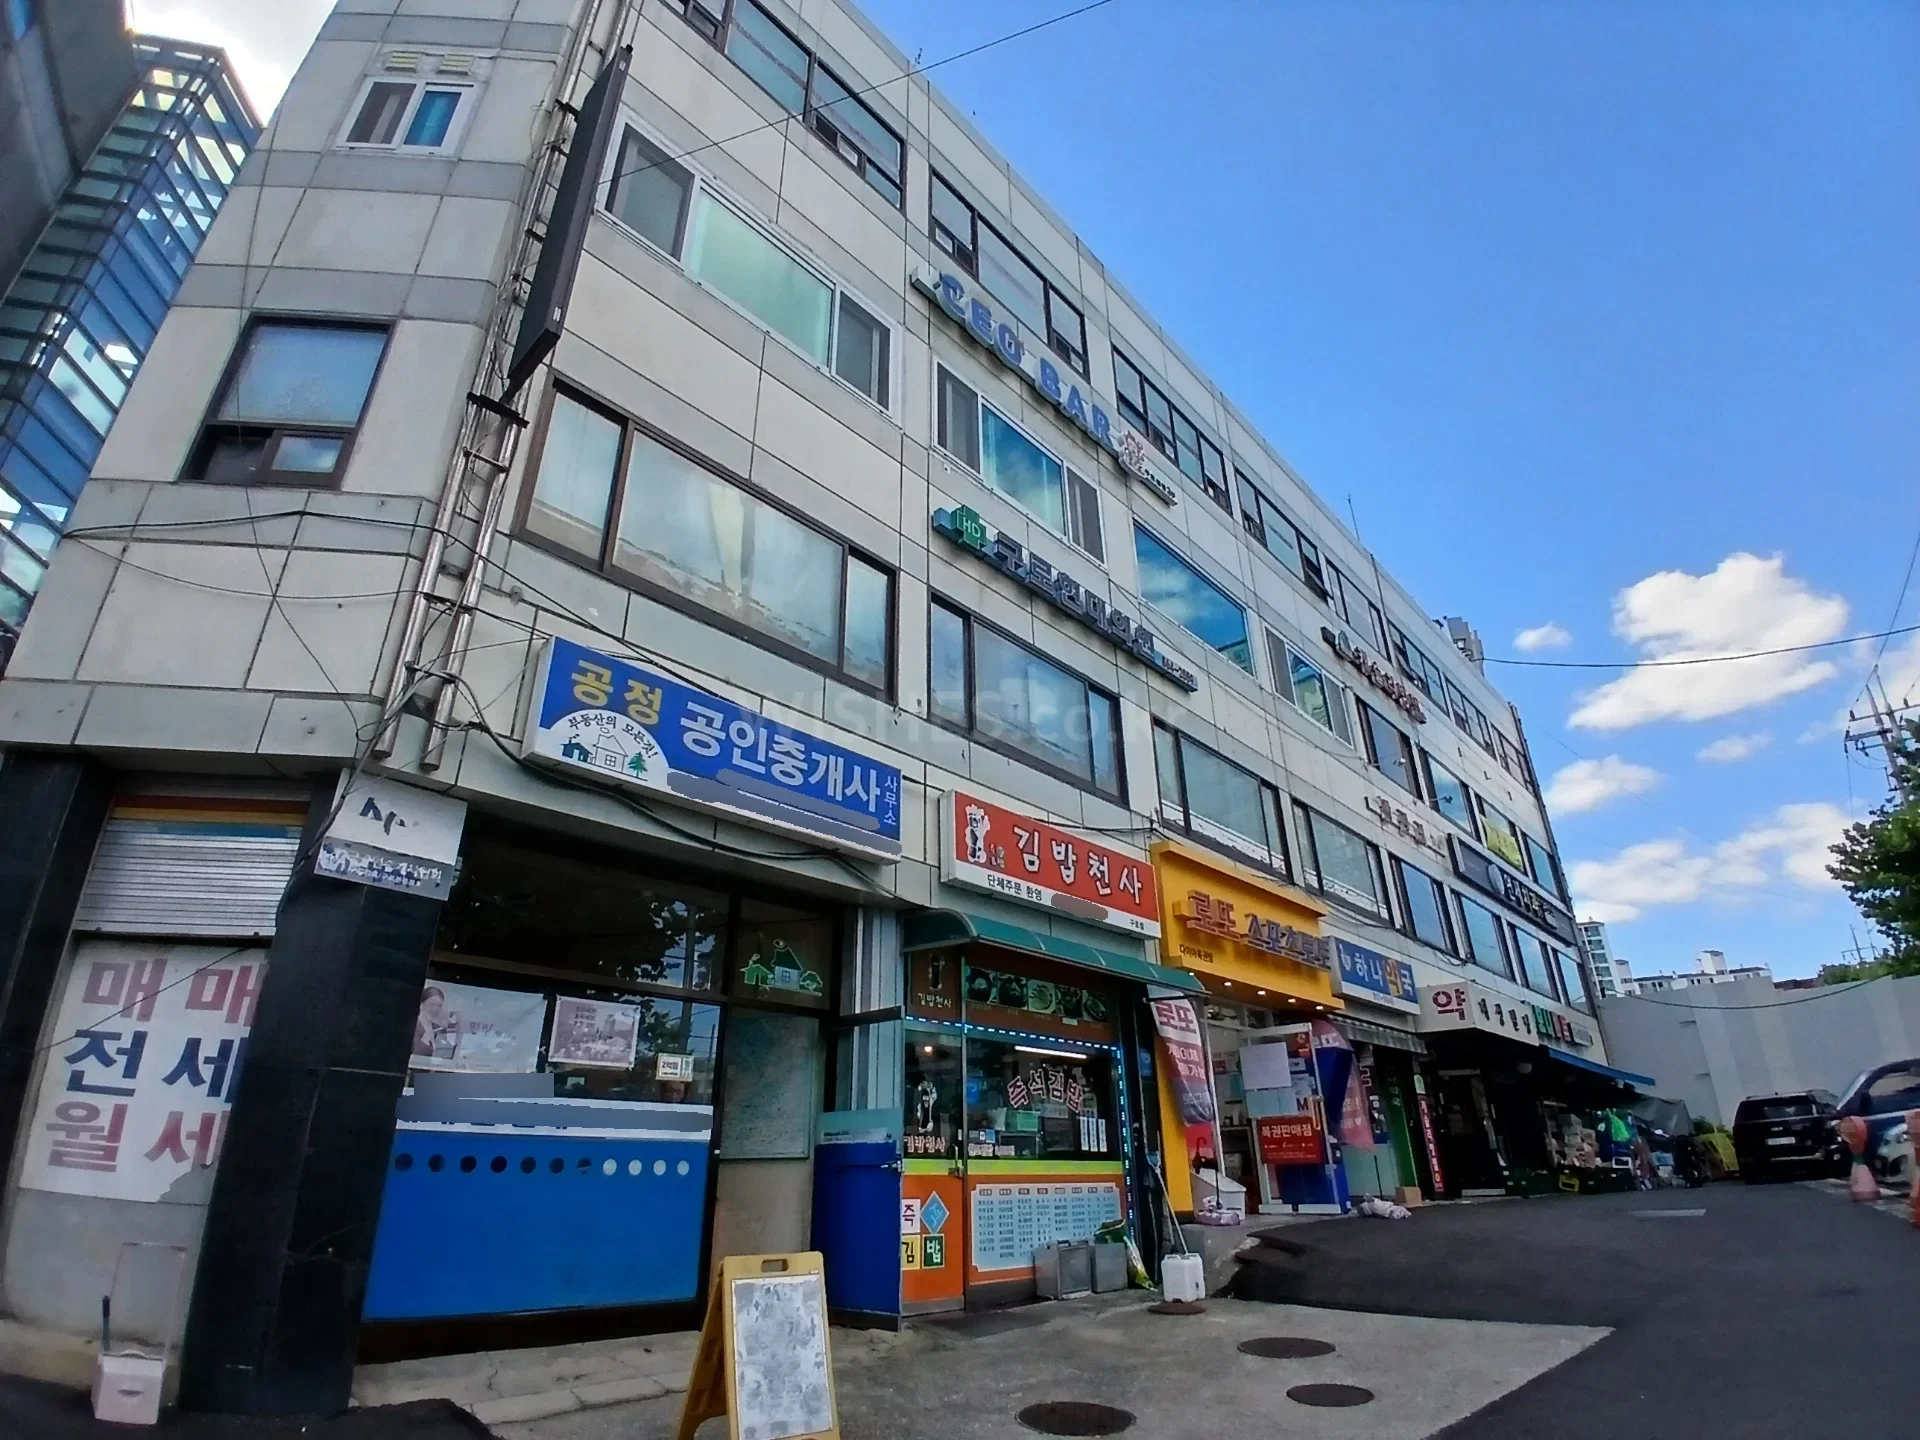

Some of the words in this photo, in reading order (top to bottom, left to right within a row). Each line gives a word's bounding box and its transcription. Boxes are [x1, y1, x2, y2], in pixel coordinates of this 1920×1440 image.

[1038, 356, 1114, 449] BAR
[962, 516, 982, 539] HD
[571, 658, 662, 726] 공정
[567, 711, 617, 731] 부동산의
[679, 700, 882, 813] 공인중개사
[883, 775, 898, 827] 사무소
[986, 873, 1022, 896] 단체주문
[1026, 885, 1043, 902] 환영
[1012, 824, 1143, 905] 김밥천사
[1186, 888, 1241, 942] 로또
[1353, 952, 1414, 997] 하나약국
[1155, 1000, 1198, 1035] 로또
[1432, 988, 1467, 1021] 약
[63, 1028, 250, 1104] 전세
[1007, 1067, 1084, 1114] 즉석김밥
[45, 1100, 231, 1173] 월세
[1261, 1120, 1313, 1139] 복권판매점
